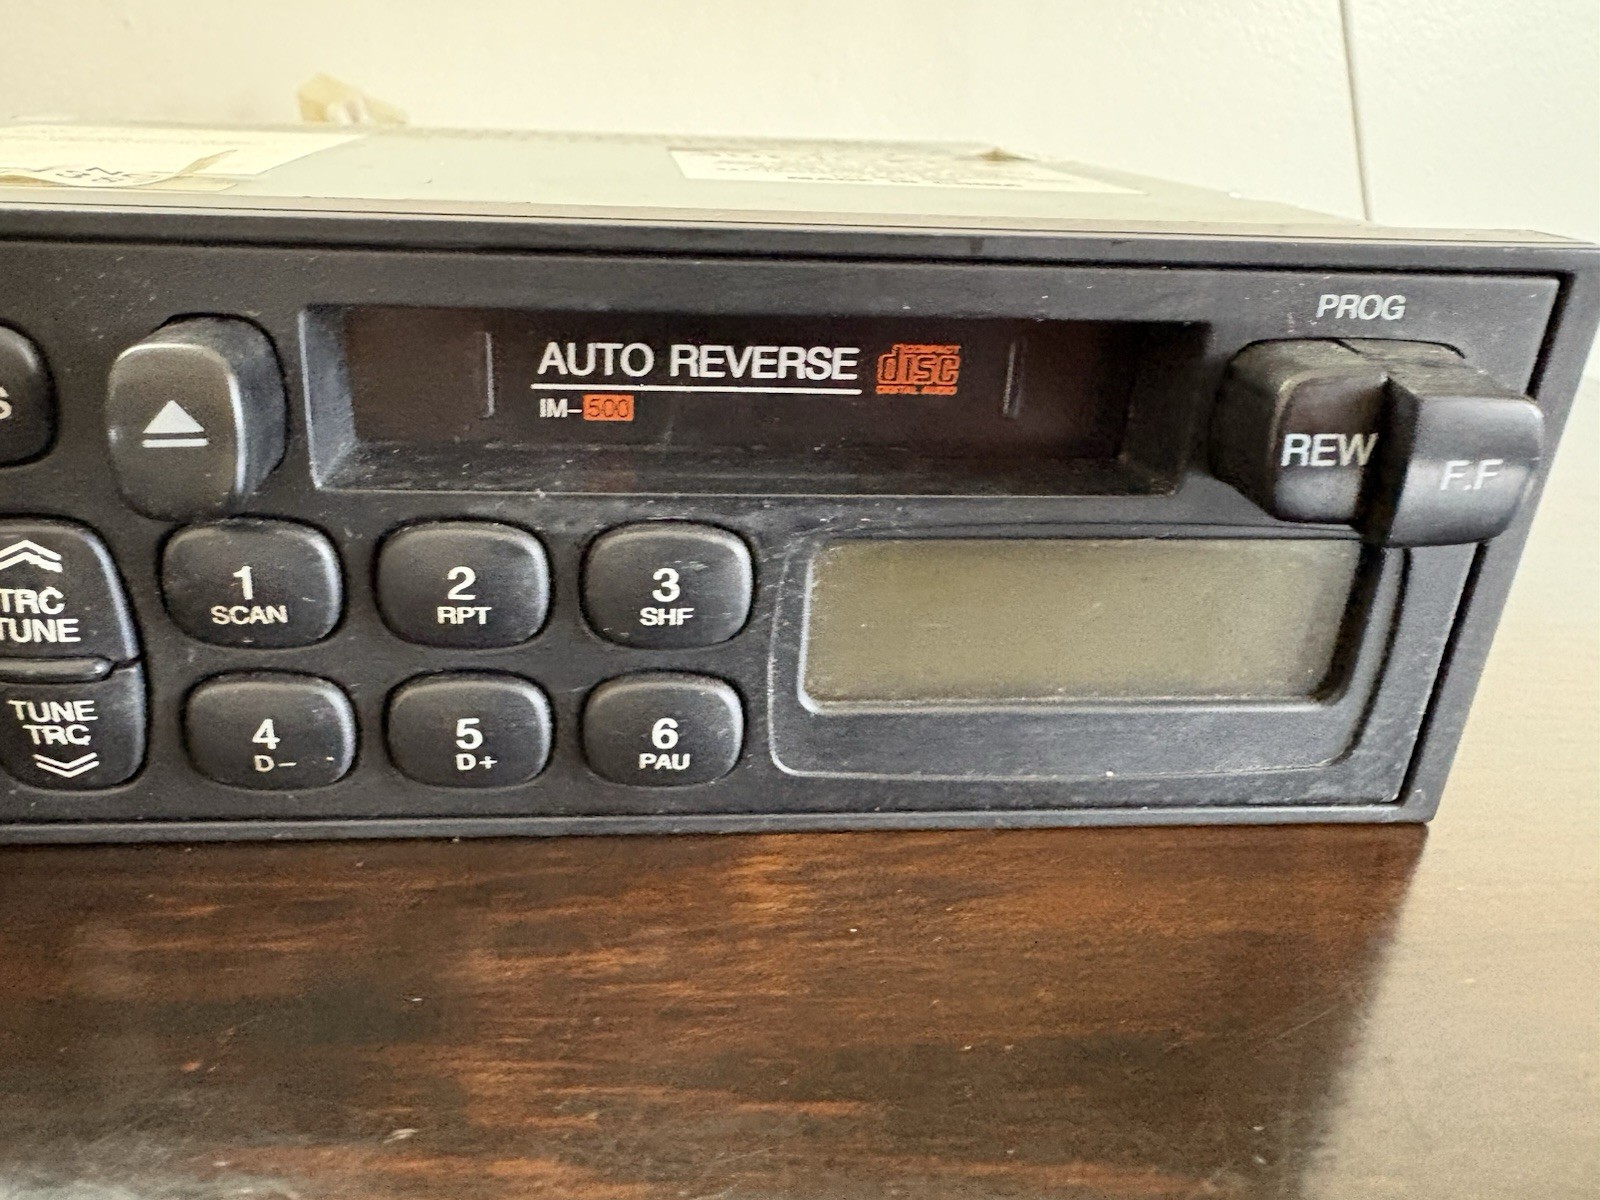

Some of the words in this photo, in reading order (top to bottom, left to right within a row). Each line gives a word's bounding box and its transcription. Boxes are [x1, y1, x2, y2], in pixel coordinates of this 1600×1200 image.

[1316, 294, 1406, 321] PROG
[537, 341, 655, 377] AUTO
[670, 344, 860, 381] REVERSE
[1280, 433, 1378, 467] REW
[1440, 459, 1503, 491] F.F
[233, 565, 253, 600] 1
[447, 566, 476, 601] 2
[652, 567, 680, 603] 3
[0, 587, 66, 614] TRC
[210, 605, 289, 625] SCAN
[437, 606, 492, 625] RPT
[639, 606, 695, 626] SHF
[8, 700, 99, 723] TUNE
[22, 723, 91, 746] TRC
[251, 718, 280, 750] 4
[456, 717, 483, 750] 5
[651, 717, 679, 750] 6
[455, 752, 497, 771] D+
[639, 753, 691, 771] PAU
